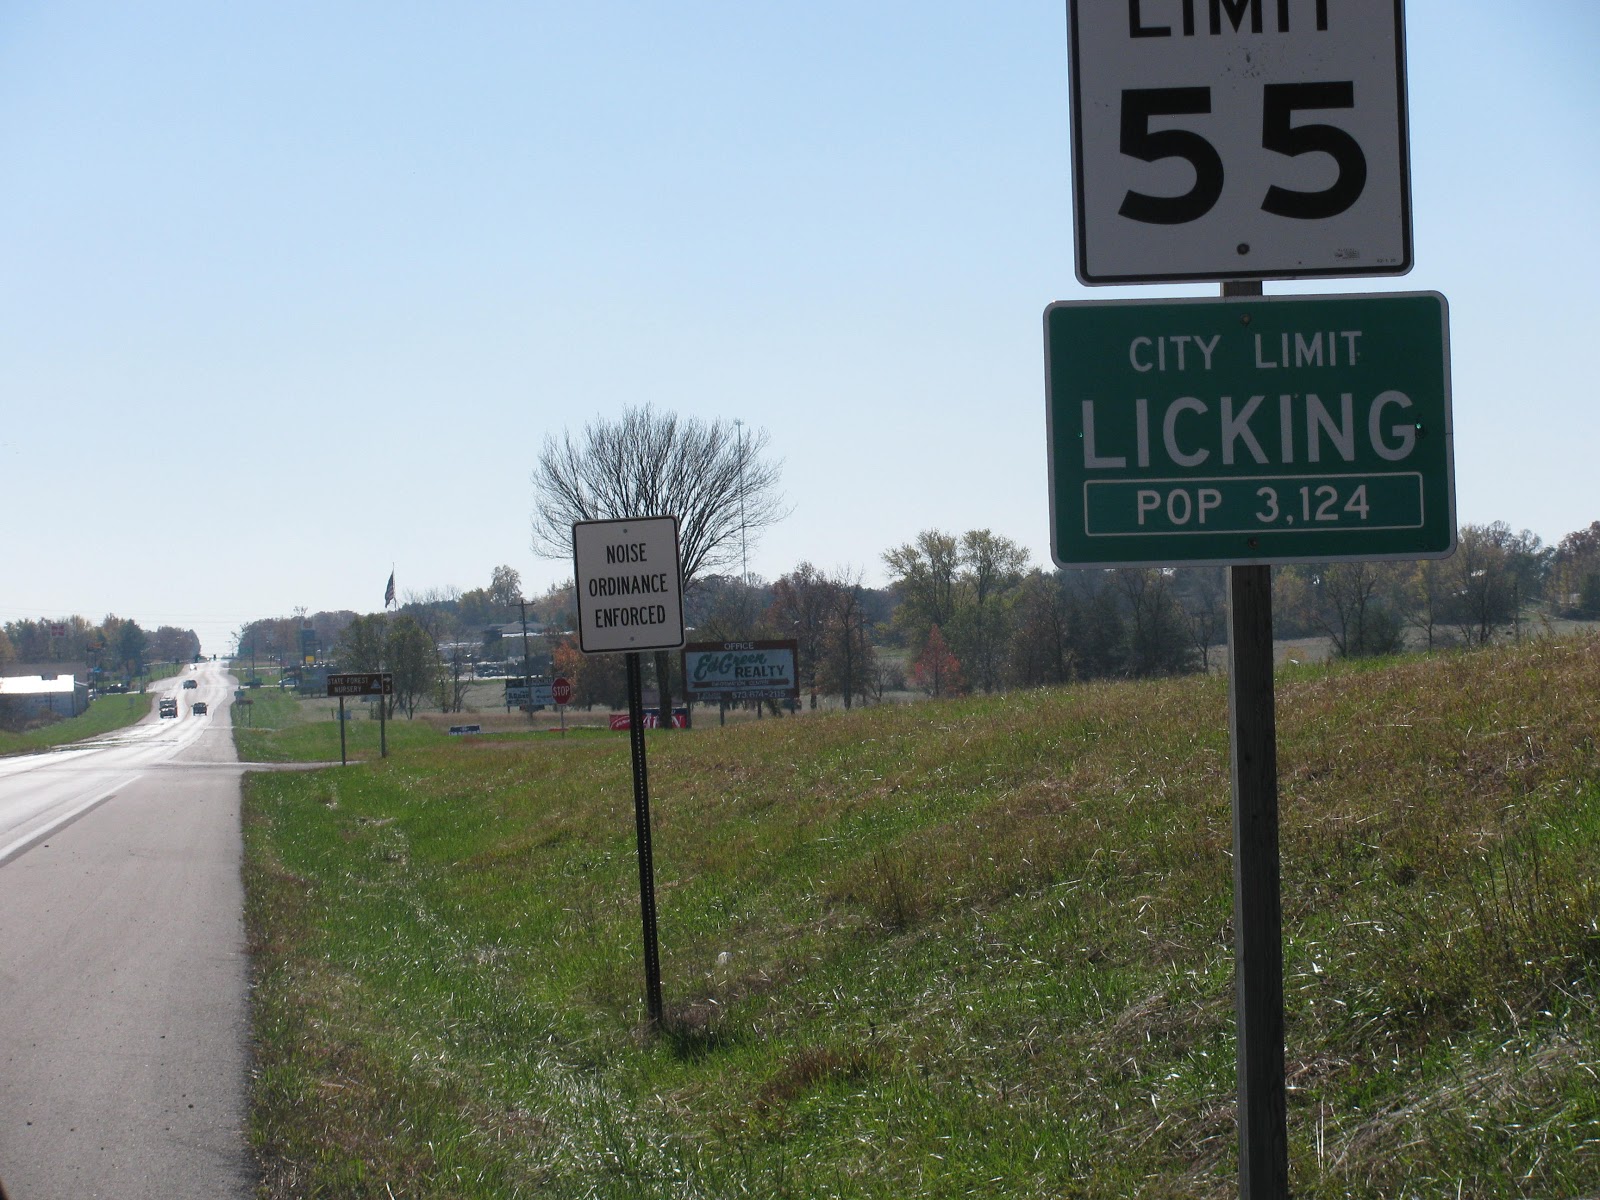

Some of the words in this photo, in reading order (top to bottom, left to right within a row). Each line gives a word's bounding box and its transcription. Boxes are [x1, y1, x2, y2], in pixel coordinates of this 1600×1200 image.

[1118, 81, 1367, 225] 55
[1129, 335, 1221, 372] CITY
[1255, 331, 1362, 369] LIMIT
[1082, 390, 1416, 469] LICKING
[1137, 488, 1222, 525] POP
[1255, 485, 1370, 526] 3,124
[606, 543, 647, 564] NOISE
[589, 574, 668, 597] ORDINANCE
[595, 605, 666, 628] ENFORCED
[724, 642, 754, 650] OFFICE
[346, 676, 368, 684] FOREST
[734, 665, 785, 678] REALTY
[334, 685, 362, 693] NURSERY
[553, 686, 570, 697] STOP
